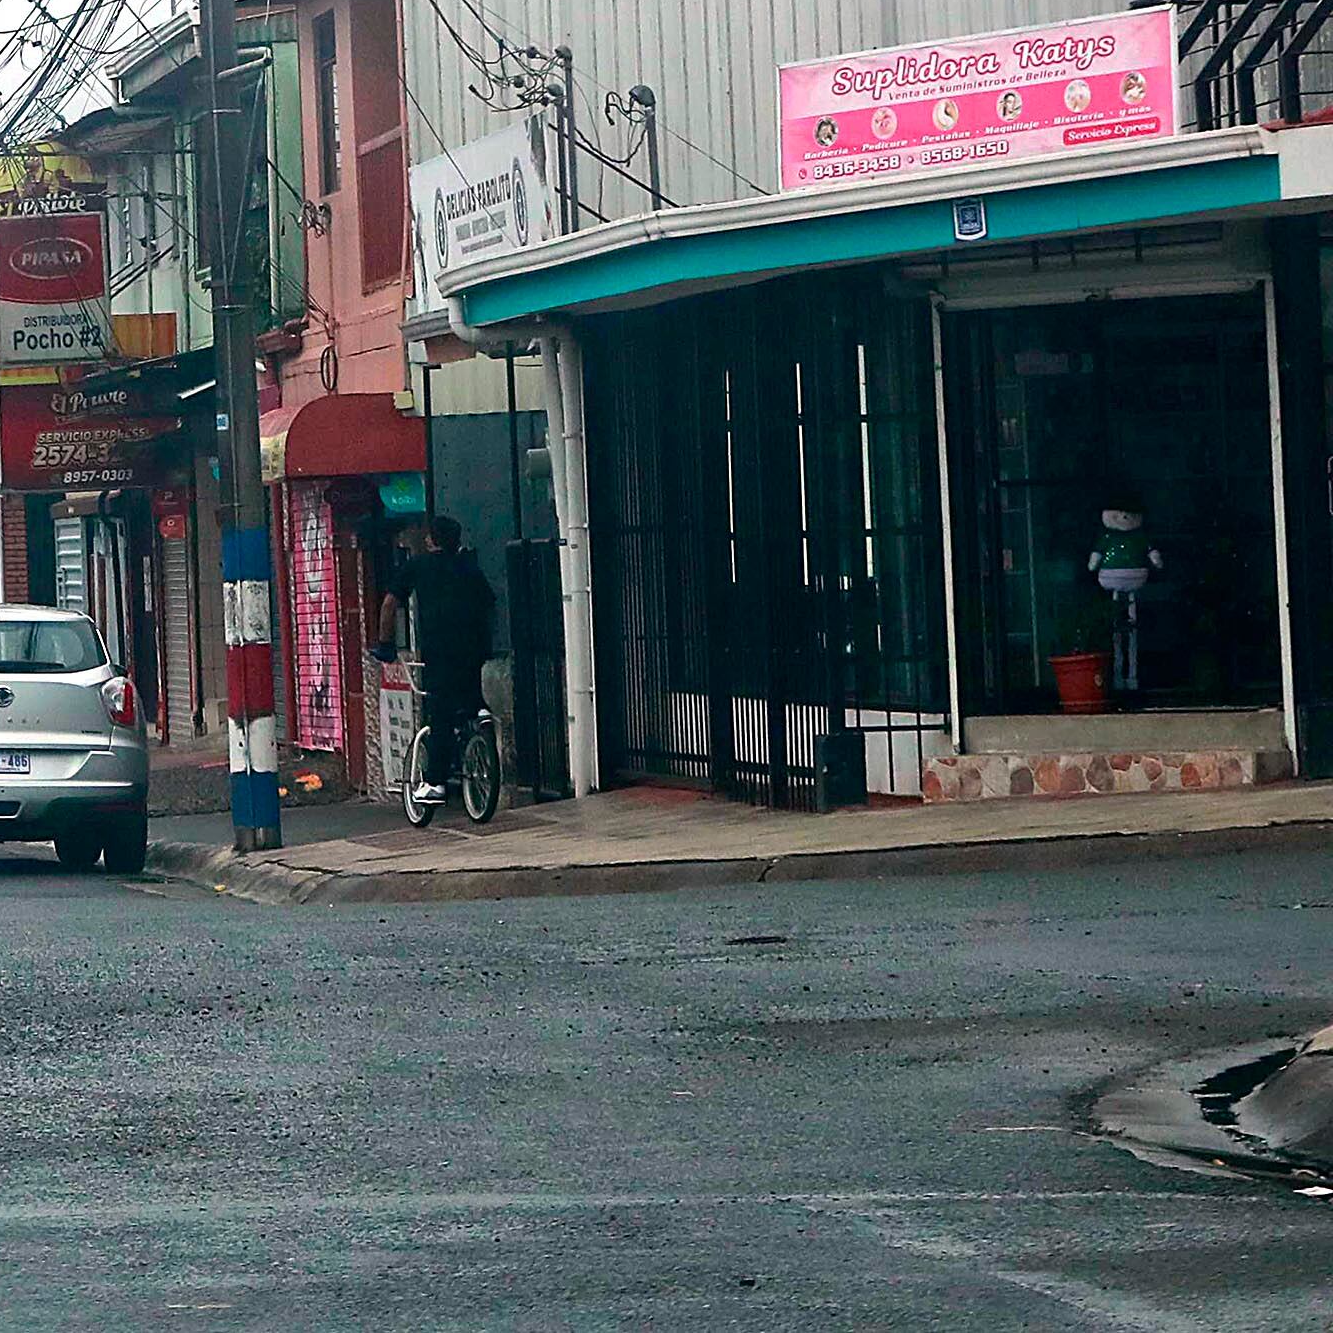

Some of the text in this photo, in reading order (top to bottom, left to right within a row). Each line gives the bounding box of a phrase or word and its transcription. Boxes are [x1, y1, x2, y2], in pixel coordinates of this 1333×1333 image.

[832, 36, 1115, 100] Suplidora Katys
[888, 69, 1066, 101] Venta de Suministros de Belleza
[862, 139, 908, 151] Pedicure
[984, 120, 1040, 135] Maquillaje
[1068, 122, 1156, 141] Servicio Express
[813, 140, 1009, 179] 8436-3458 8568-1650
[21, 249, 82, 266] PIPASA
[13, 325, 104, 350] Pocho #2
[37, 430, 92, 444] SERVICIO
[63, 469, 133, 483] 8957-0303
